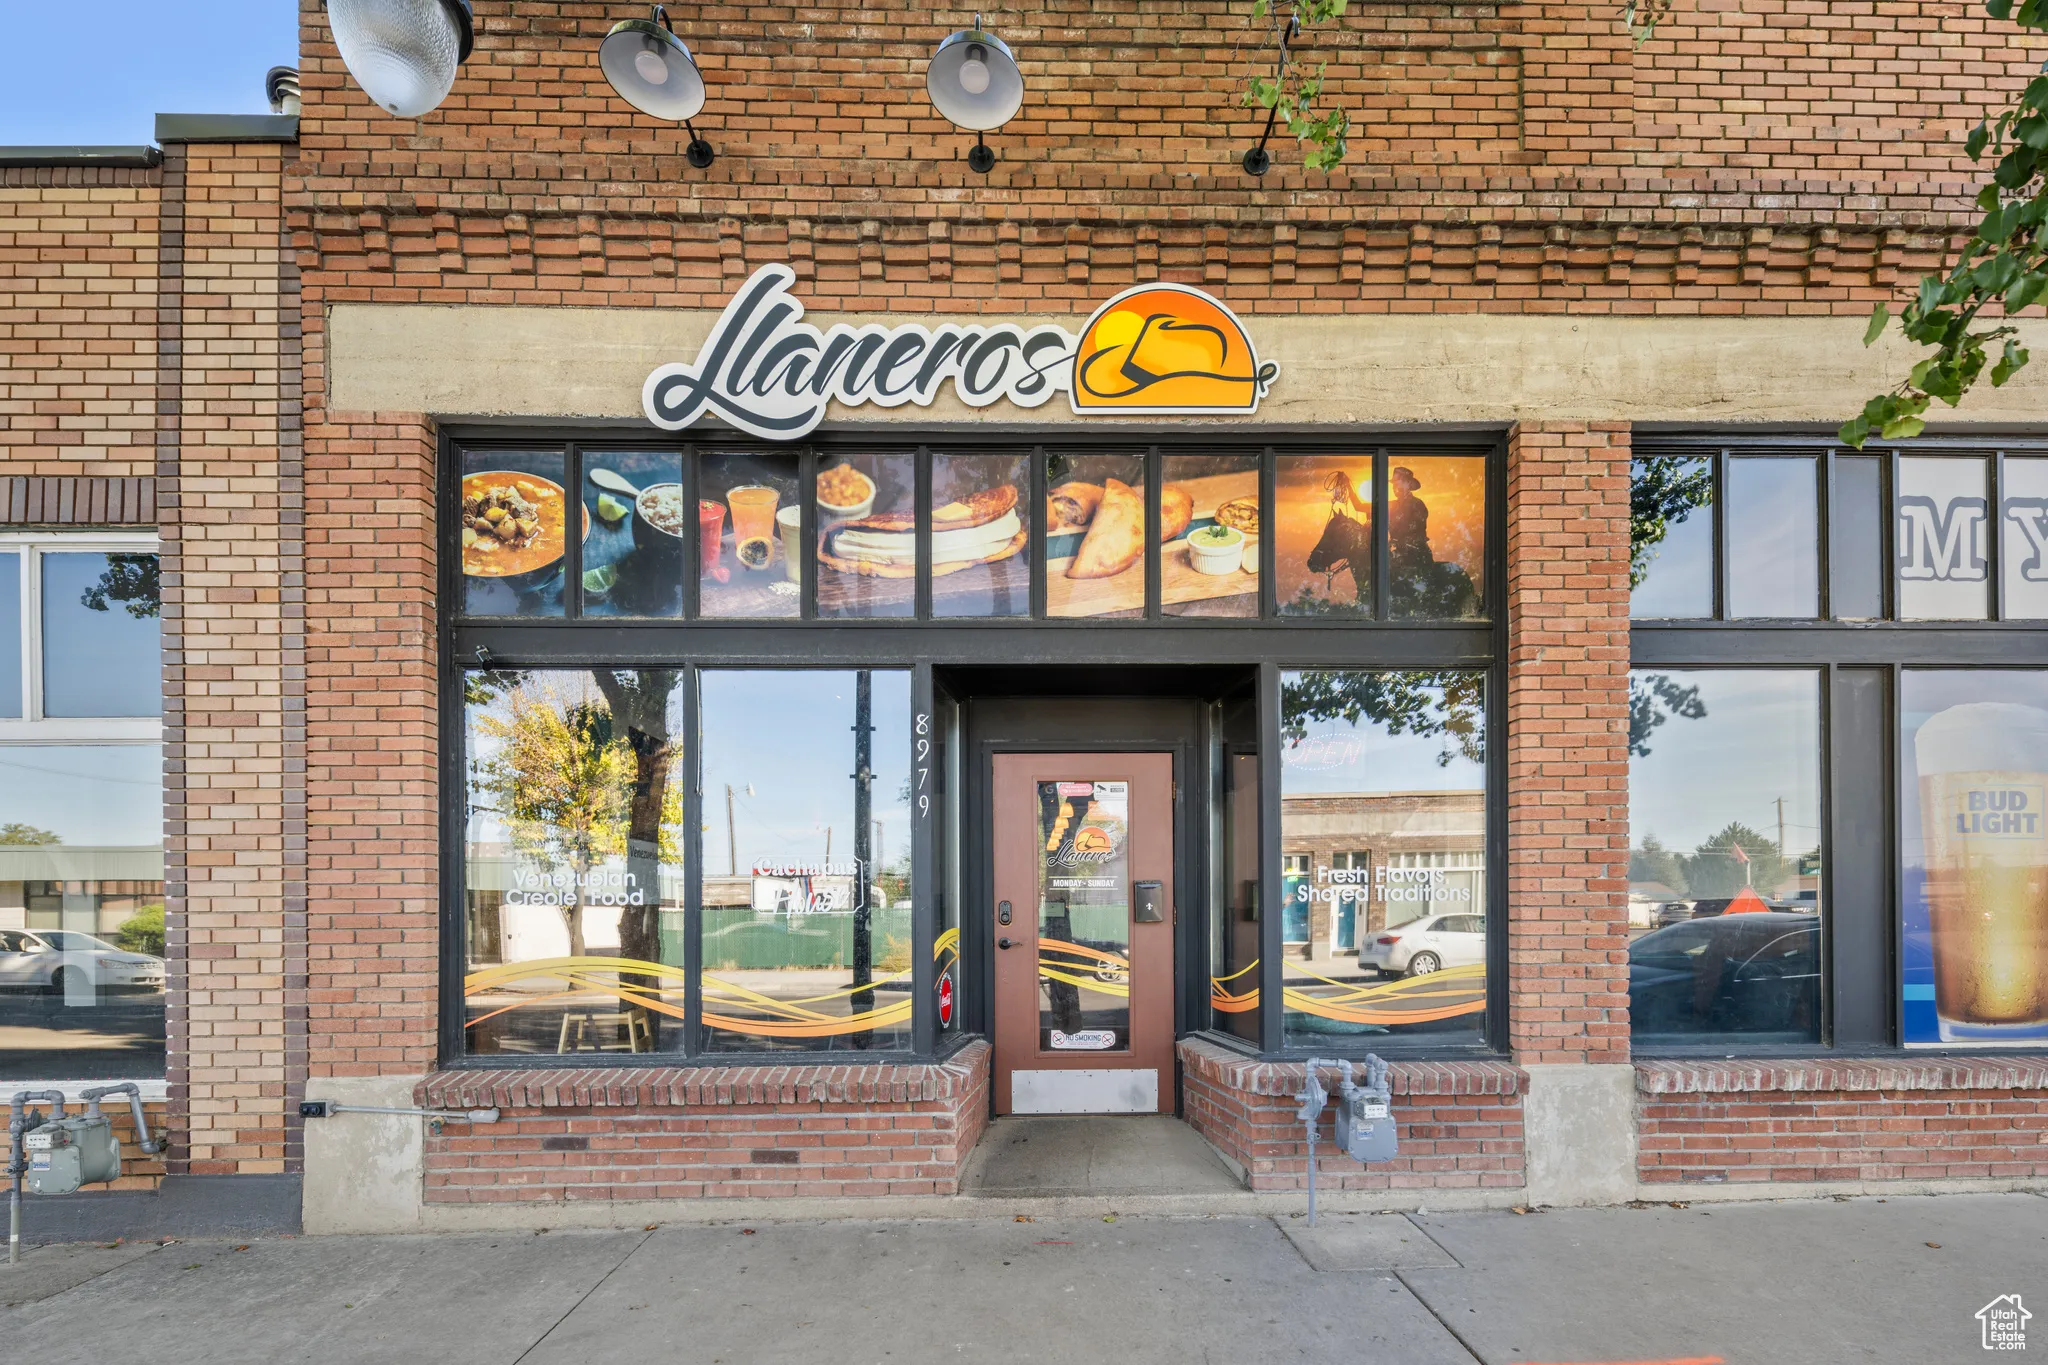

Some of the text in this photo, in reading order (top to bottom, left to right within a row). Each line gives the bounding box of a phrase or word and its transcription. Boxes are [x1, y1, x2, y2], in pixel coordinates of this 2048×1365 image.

[653, 273, 1070, 430] Llaneros
[1286, 739, 1361, 765] OPEN
[916, 714, 929, 818] 8979
[1968, 790, 2028, 812] BUD
[1956, 812, 2039, 834] LIGHT
[1047, 839, 1116, 868] Llaneros
[512, 869, 636, 887] Venezuelan
[758, 858, 858, 881] Cachapas
[1317, 865, 1368, 883] Fresh
[1053, 879, 1081, 887] MONDAY
[1087, 879, 1115, 887] SUNDAY
[1297, 884, 1471, 902] Shared Traditions
[506, 888, 644, 906] Creole Food
[1075, 1034, 1102, 1042] SMOKING
